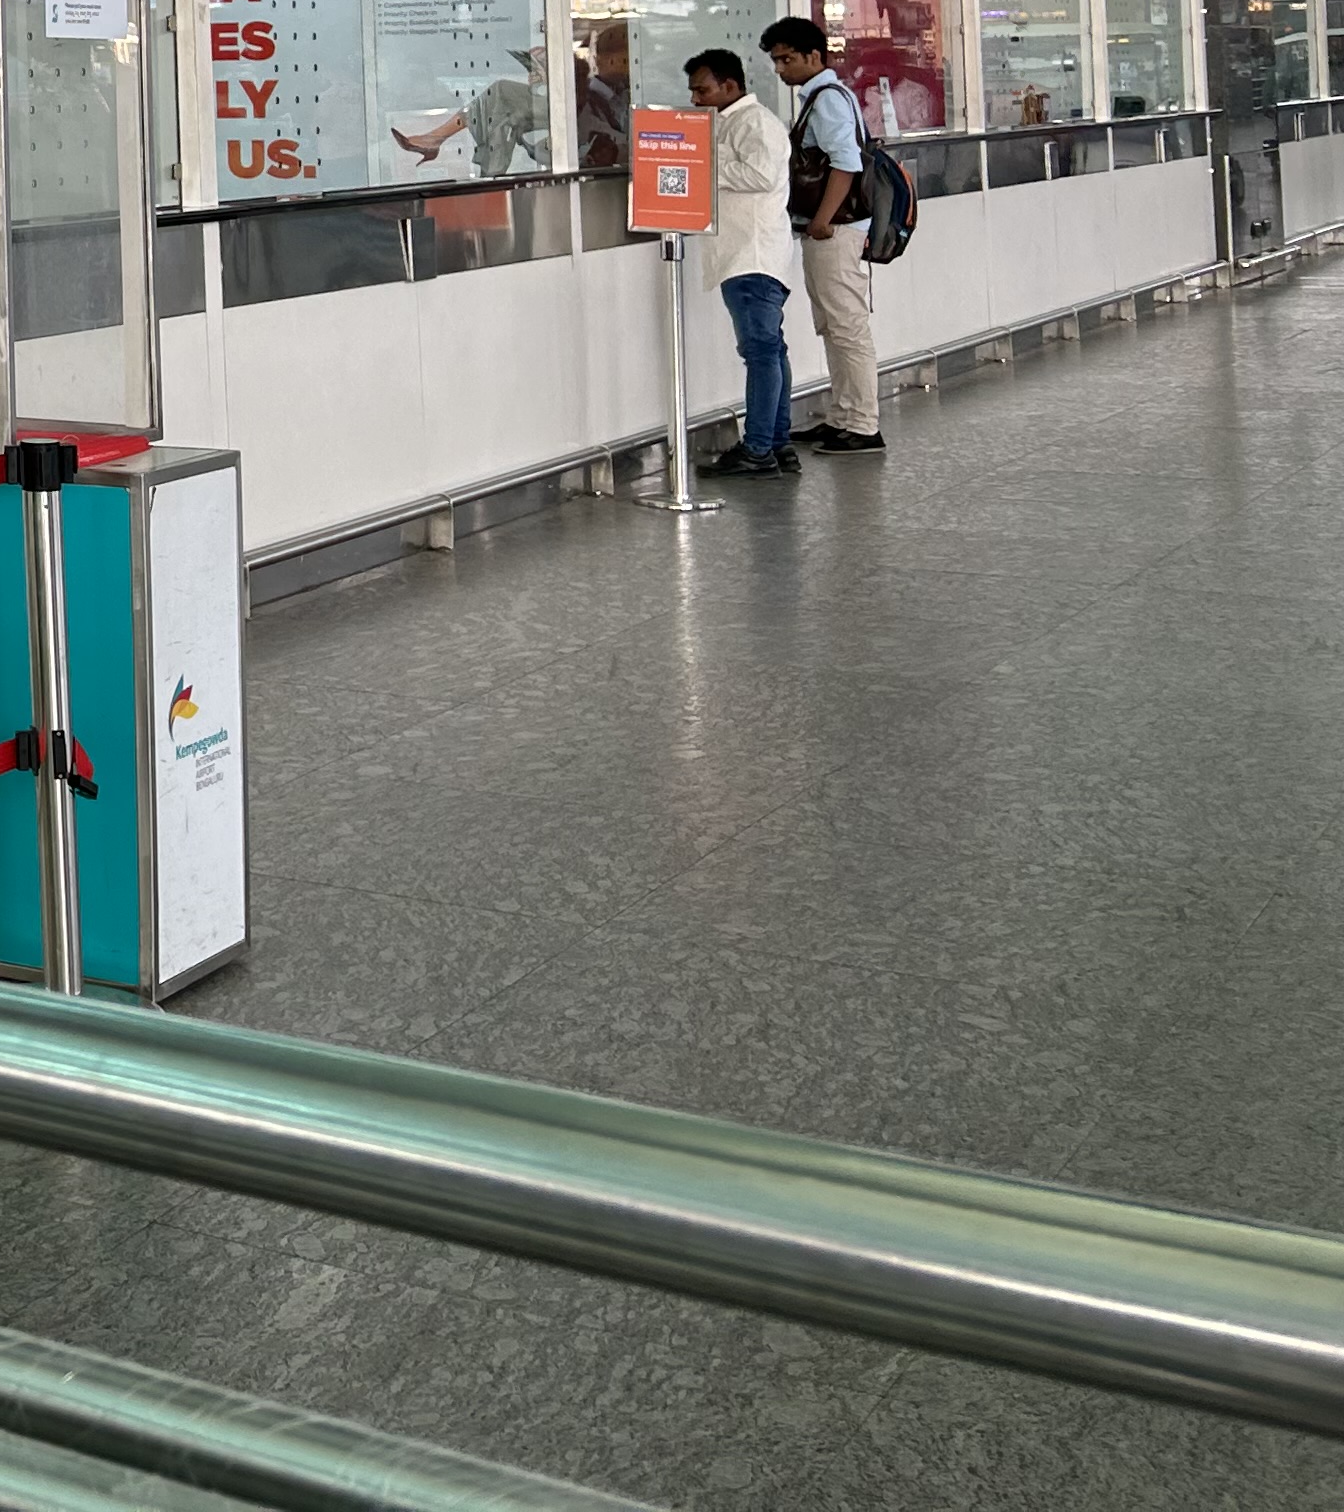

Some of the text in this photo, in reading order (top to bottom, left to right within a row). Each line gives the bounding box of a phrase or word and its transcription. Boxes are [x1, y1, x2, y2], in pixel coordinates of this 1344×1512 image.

[210, 21, 277, 62] ES
[215, 80, 279, 119] LY
[227, 139, 317, 179] US.
[638, 139, 697, 152] Skip this line
[175, 727, 228, 760] Kempegowda
